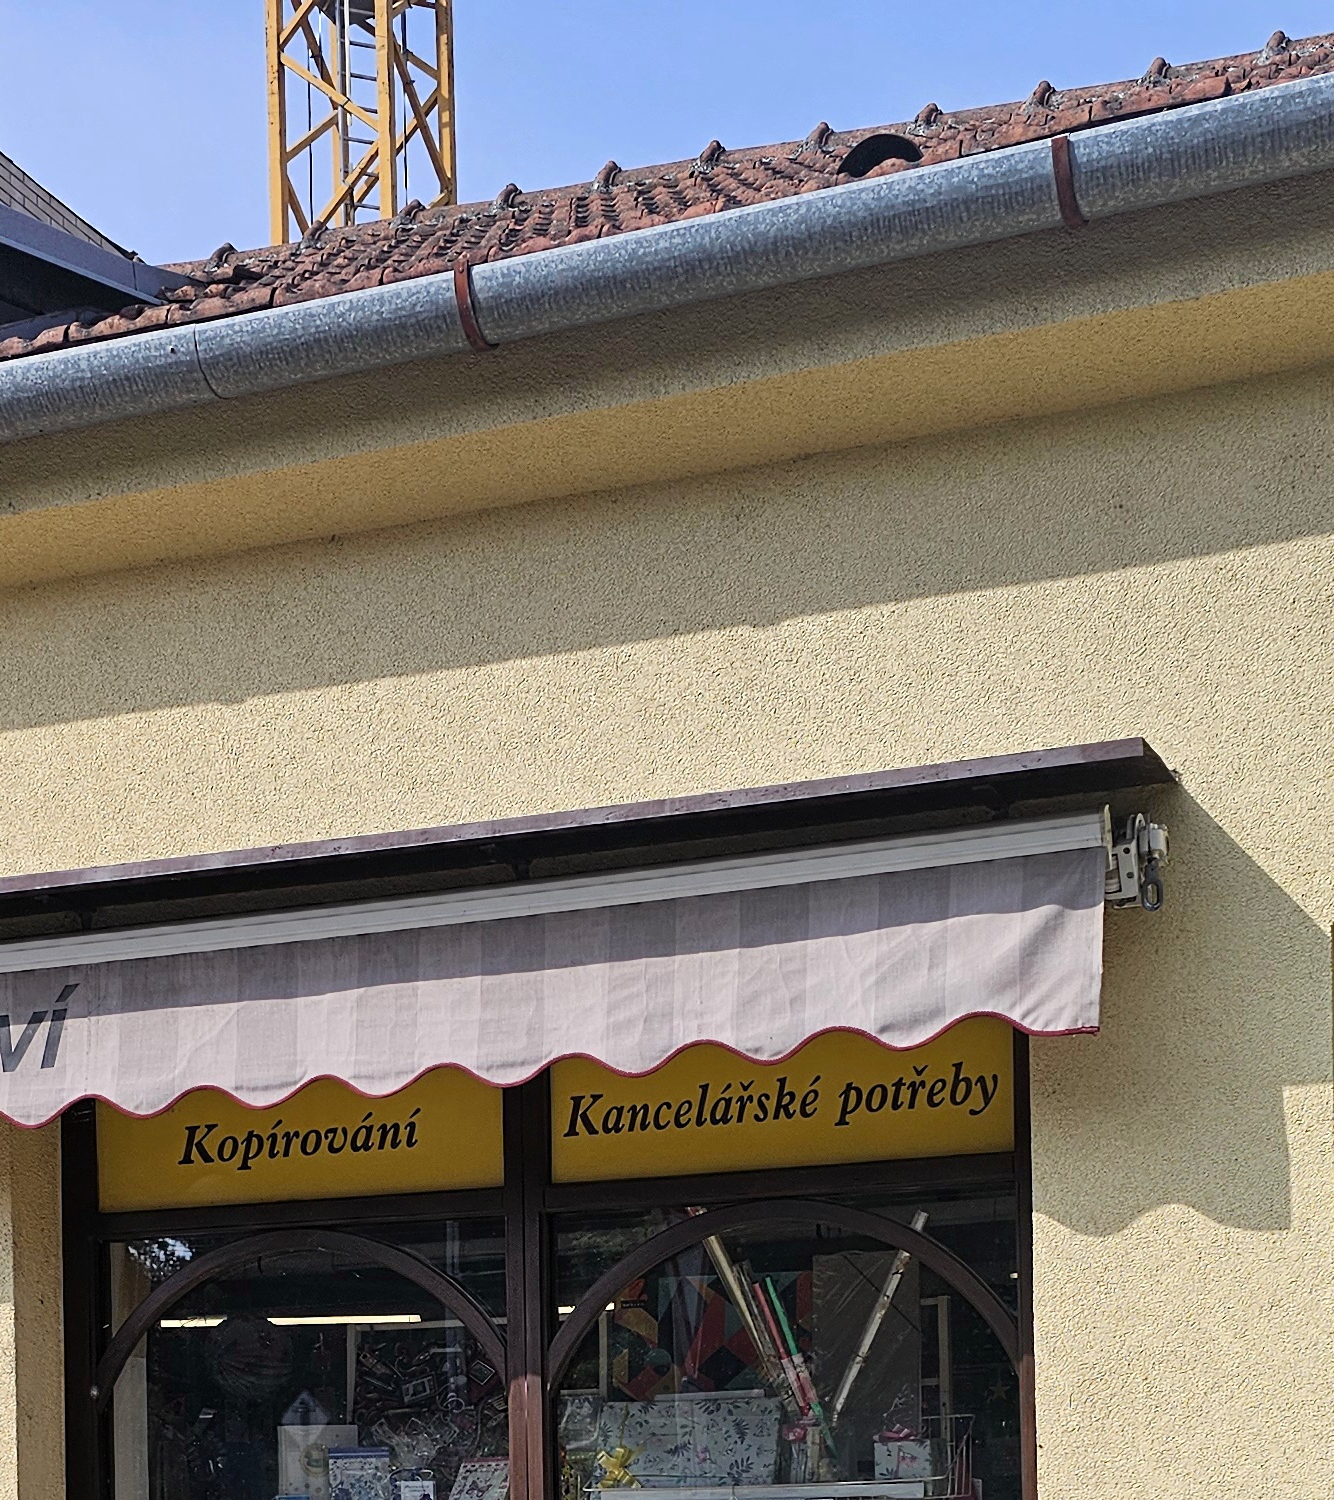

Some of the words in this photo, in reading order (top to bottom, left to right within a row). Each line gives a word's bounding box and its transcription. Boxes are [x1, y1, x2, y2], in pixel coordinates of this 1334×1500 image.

[563, 1073, 822, 1138] Kancelářské
[833, 1062, 1001, 1127] potřeby
[178, 1107, 422, 1171] Kopírování
